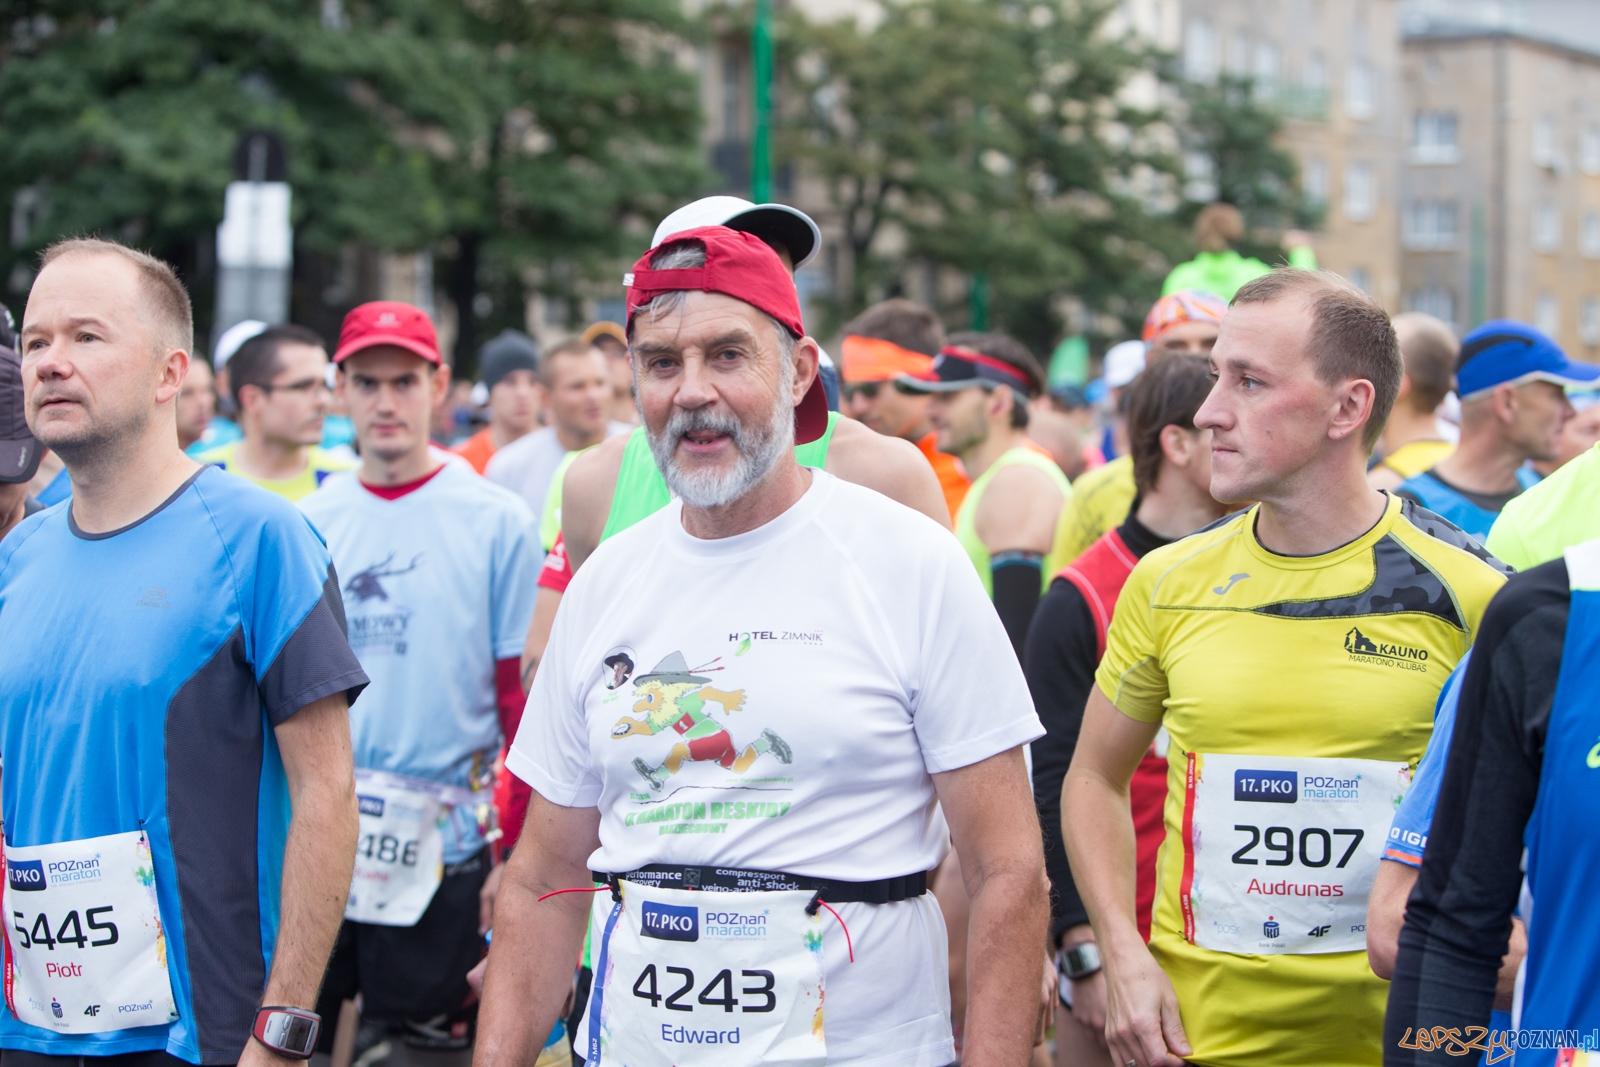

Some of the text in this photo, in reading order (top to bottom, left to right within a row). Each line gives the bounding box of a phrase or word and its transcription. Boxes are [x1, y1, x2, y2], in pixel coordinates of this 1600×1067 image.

[781, 630, 823, 642] ZIMNIK
[1379, 643, 1429, 661] KAUNO
[1348, 654, 1427, 673] MARATONO KLUBAS
[1304, 788, 1359, 799] maraton
[636, 802, 706, 826] MARATON
[710, 801, 792, 820] BESKIDY
[1231, 824, 1365, 868] 2907
[50, 868, 102, 883] maraton
[625, 869, 683, 881] performance
[715, 868, 786, 881] compressport
[736, 878, 800, 891] anti-shock
[1246, 878, 1344, 897] Audrunas
[13, 905, 119, 951] 5445
[706, 925, 767, 936] maraton
[1307, 925, 1332, 938] 4F
[46, 961, 83, 978] Piotr
[632, 963, 777, 1013] 4243
[83, 1004, 101, 1017] 4F
[660, 1023, 741, 1045] Edward
